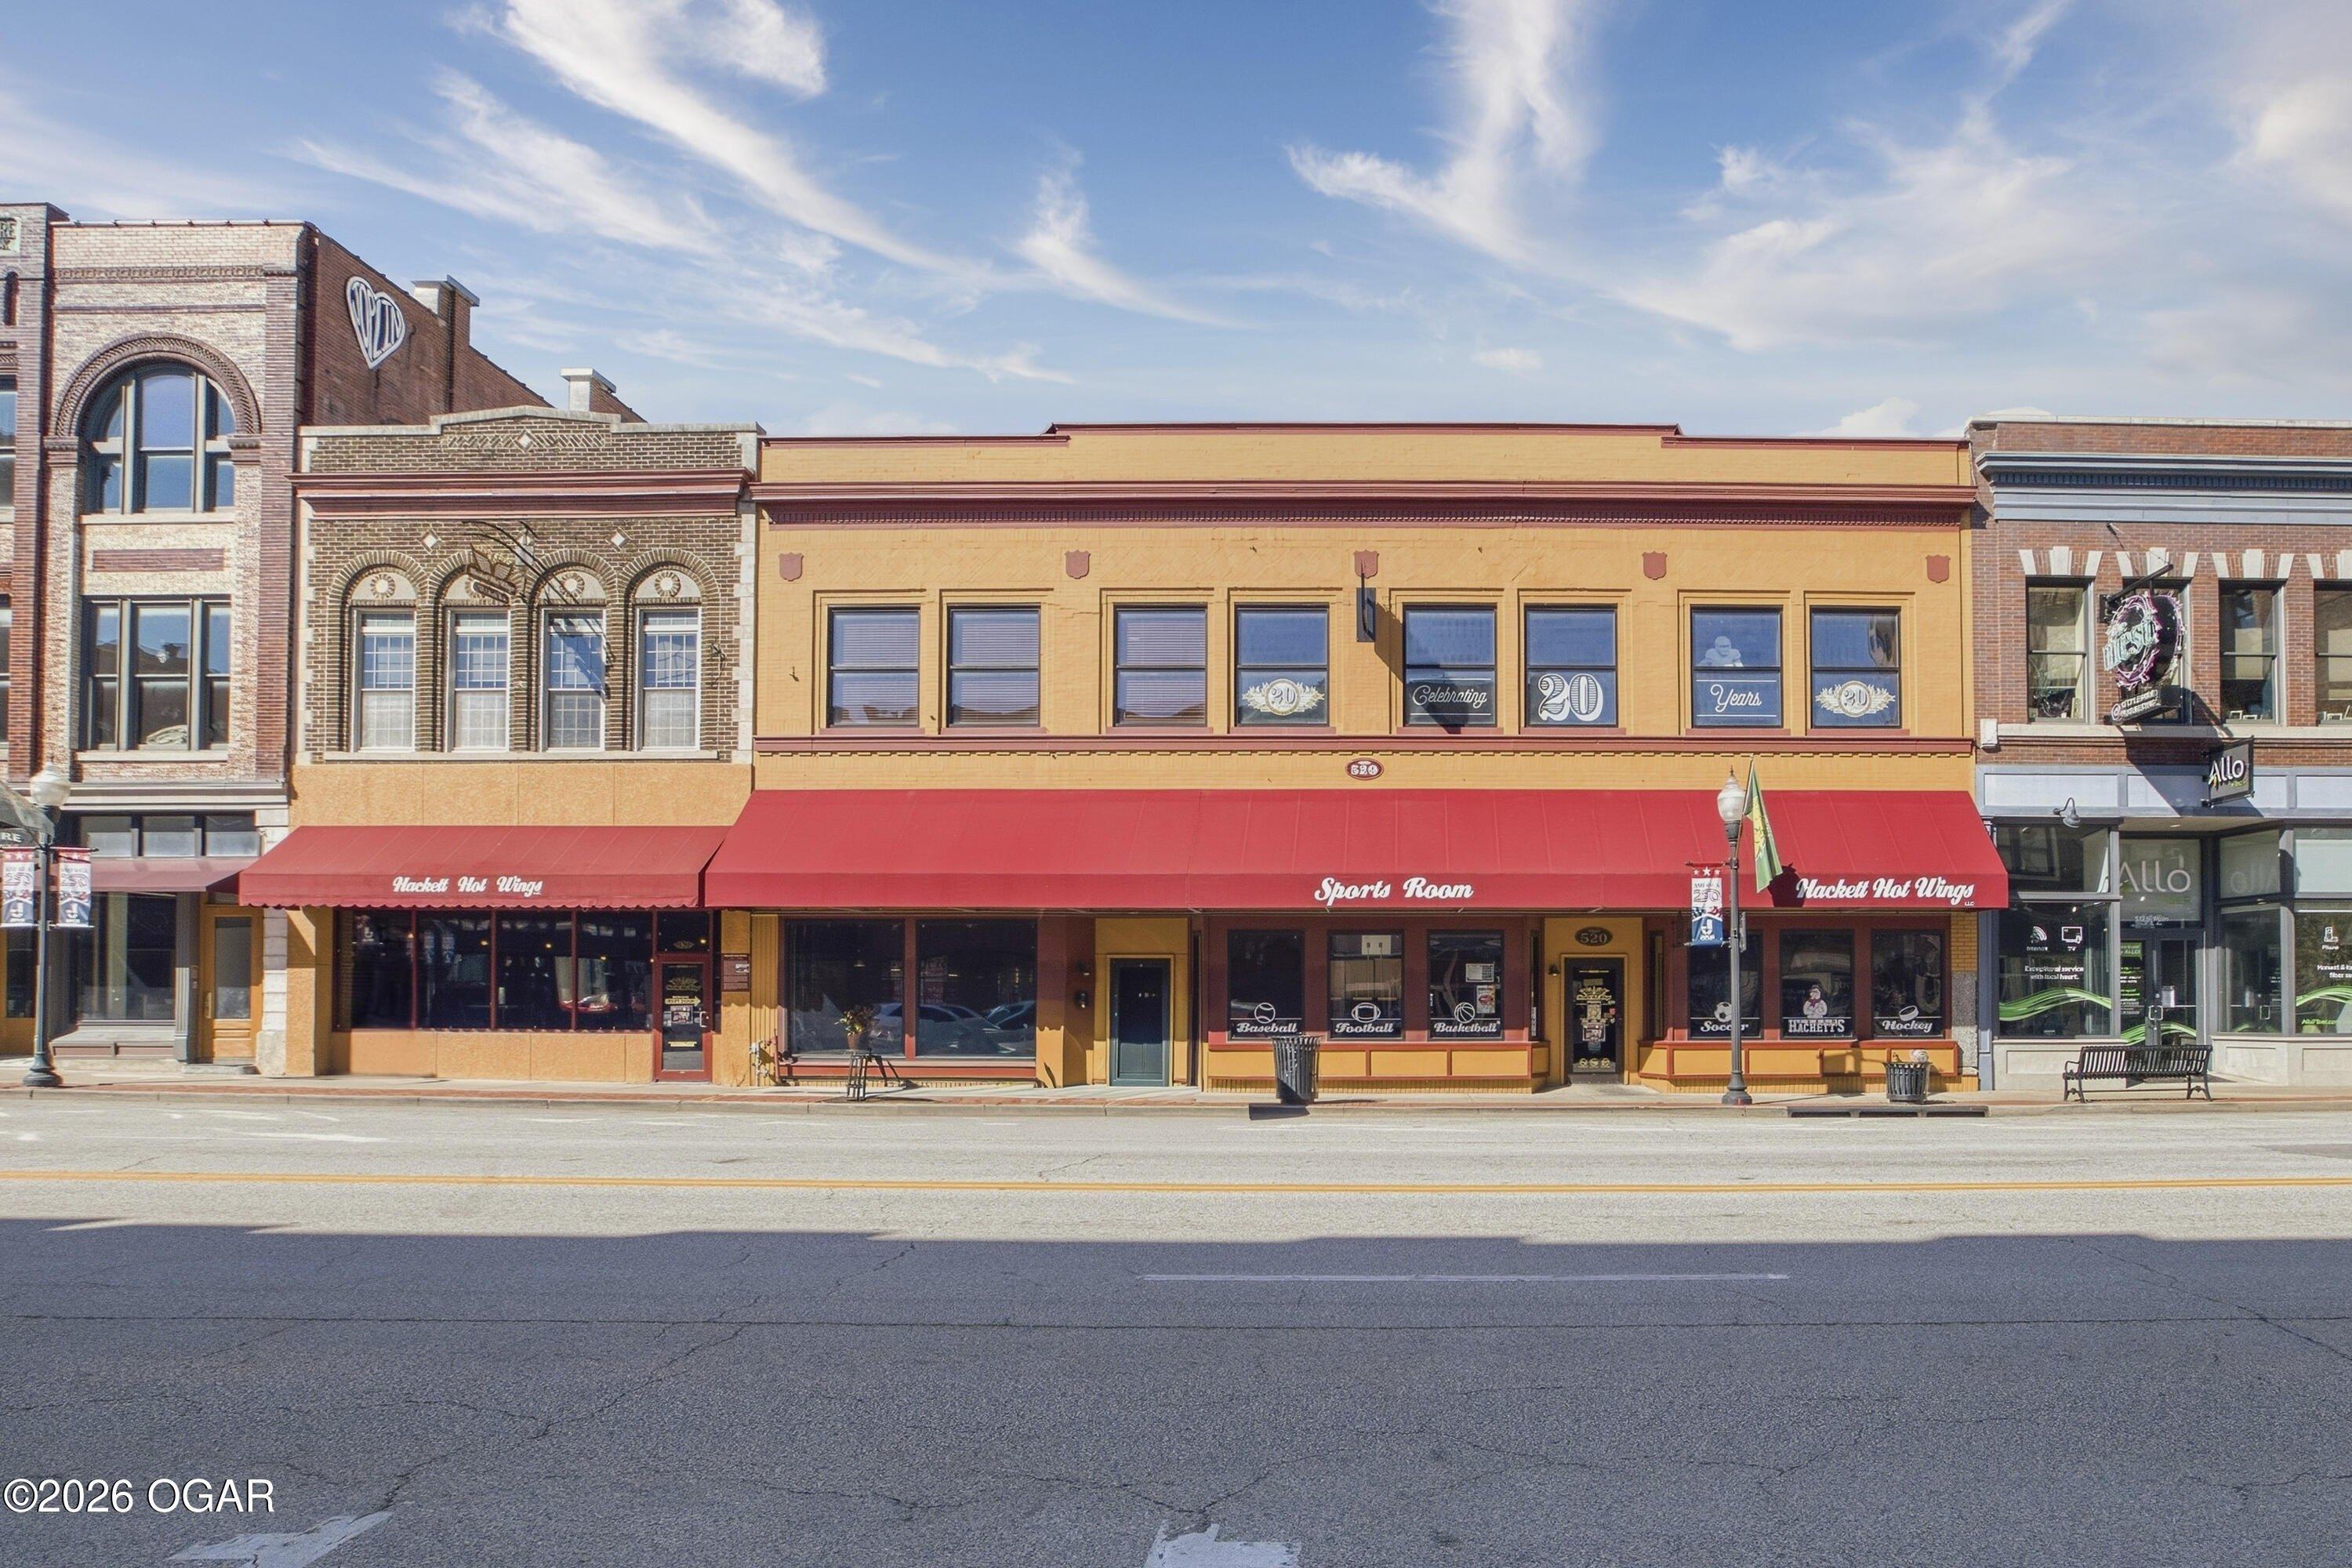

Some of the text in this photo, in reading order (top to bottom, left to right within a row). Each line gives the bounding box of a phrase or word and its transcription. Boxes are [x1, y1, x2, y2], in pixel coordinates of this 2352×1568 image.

[350, 281, 402, 362] JOPLIN
[1271, 687, 1297, 706] 20
[1412, 684, 1488, 708] Celebrating
[1537, 673, 1603, 721] 20
[1710, 684, 1762, 713] Years
[1843, 689, 1869, 706] 20
[2209, 755, 2245, 785] Allo
[393, 875, 543, 898] Hackett Hot Wings
[2119, 861, 2191, 893] Allo
[1314, 877, 1474, 907] Sports Room
[1795, 876, 1975, 906] Hackett Hot Wings
[1580, 933, 1607, 944] 520
[1236, 1022, 1298, 1033] Baseball
[1335, 1022, 1394, 1033] Football
[1434, 1022, 1497, 1032] Basketball
[1700, 1021, 1749, 1032] Soccr
[1882, 1020, 1933, 1033] Hockey
